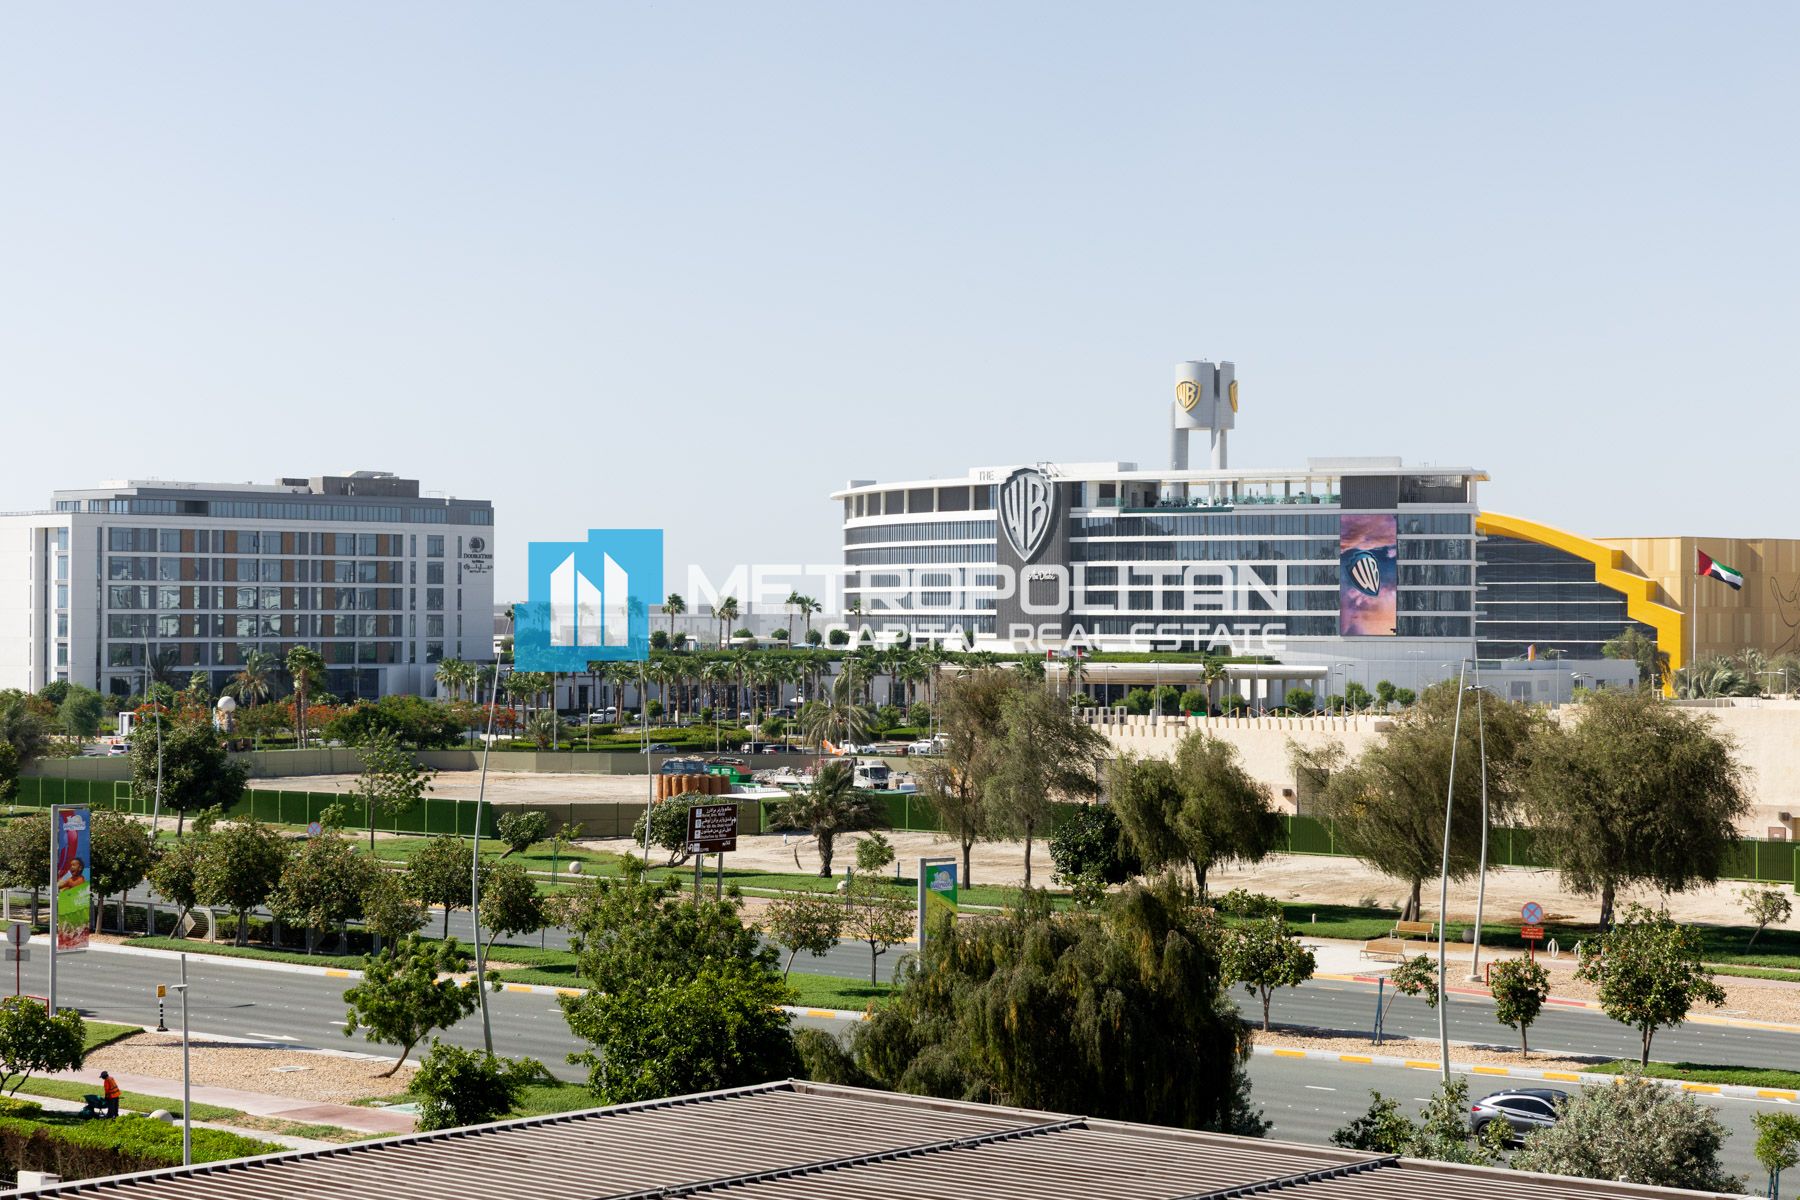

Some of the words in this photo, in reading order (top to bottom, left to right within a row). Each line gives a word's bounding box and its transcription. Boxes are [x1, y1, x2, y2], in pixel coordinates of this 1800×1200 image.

[1177, 383, 1197, 408] WB
[1004, 476, 1047, 551] WB
[1352, 557, 1380, 592] WB
